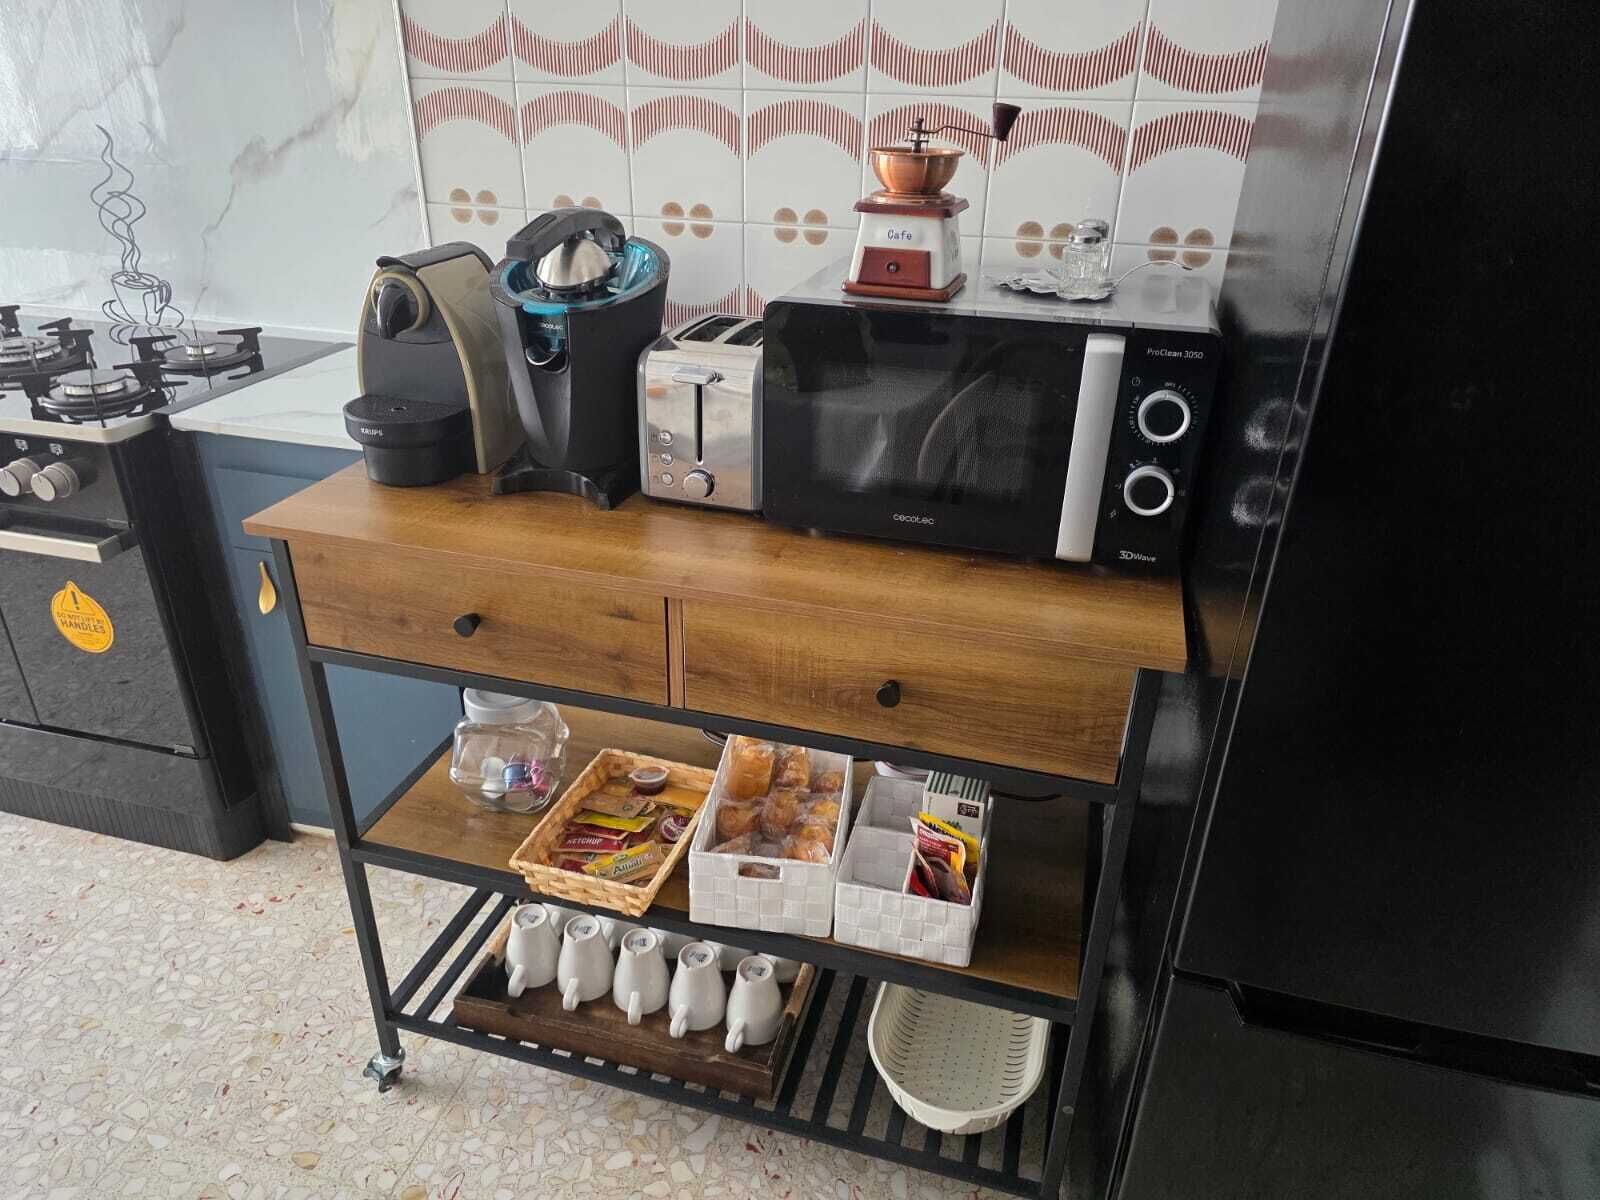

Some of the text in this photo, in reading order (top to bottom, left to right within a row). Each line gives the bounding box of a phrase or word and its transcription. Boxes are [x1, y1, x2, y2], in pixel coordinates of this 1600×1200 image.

[1146, 347, 1204, 360] ProClean 3050
[360, 428, 383, 436] KRUPS
[892, 513, 935, 525] cecotec
[566, 837, 603, 846] KETCHUP
